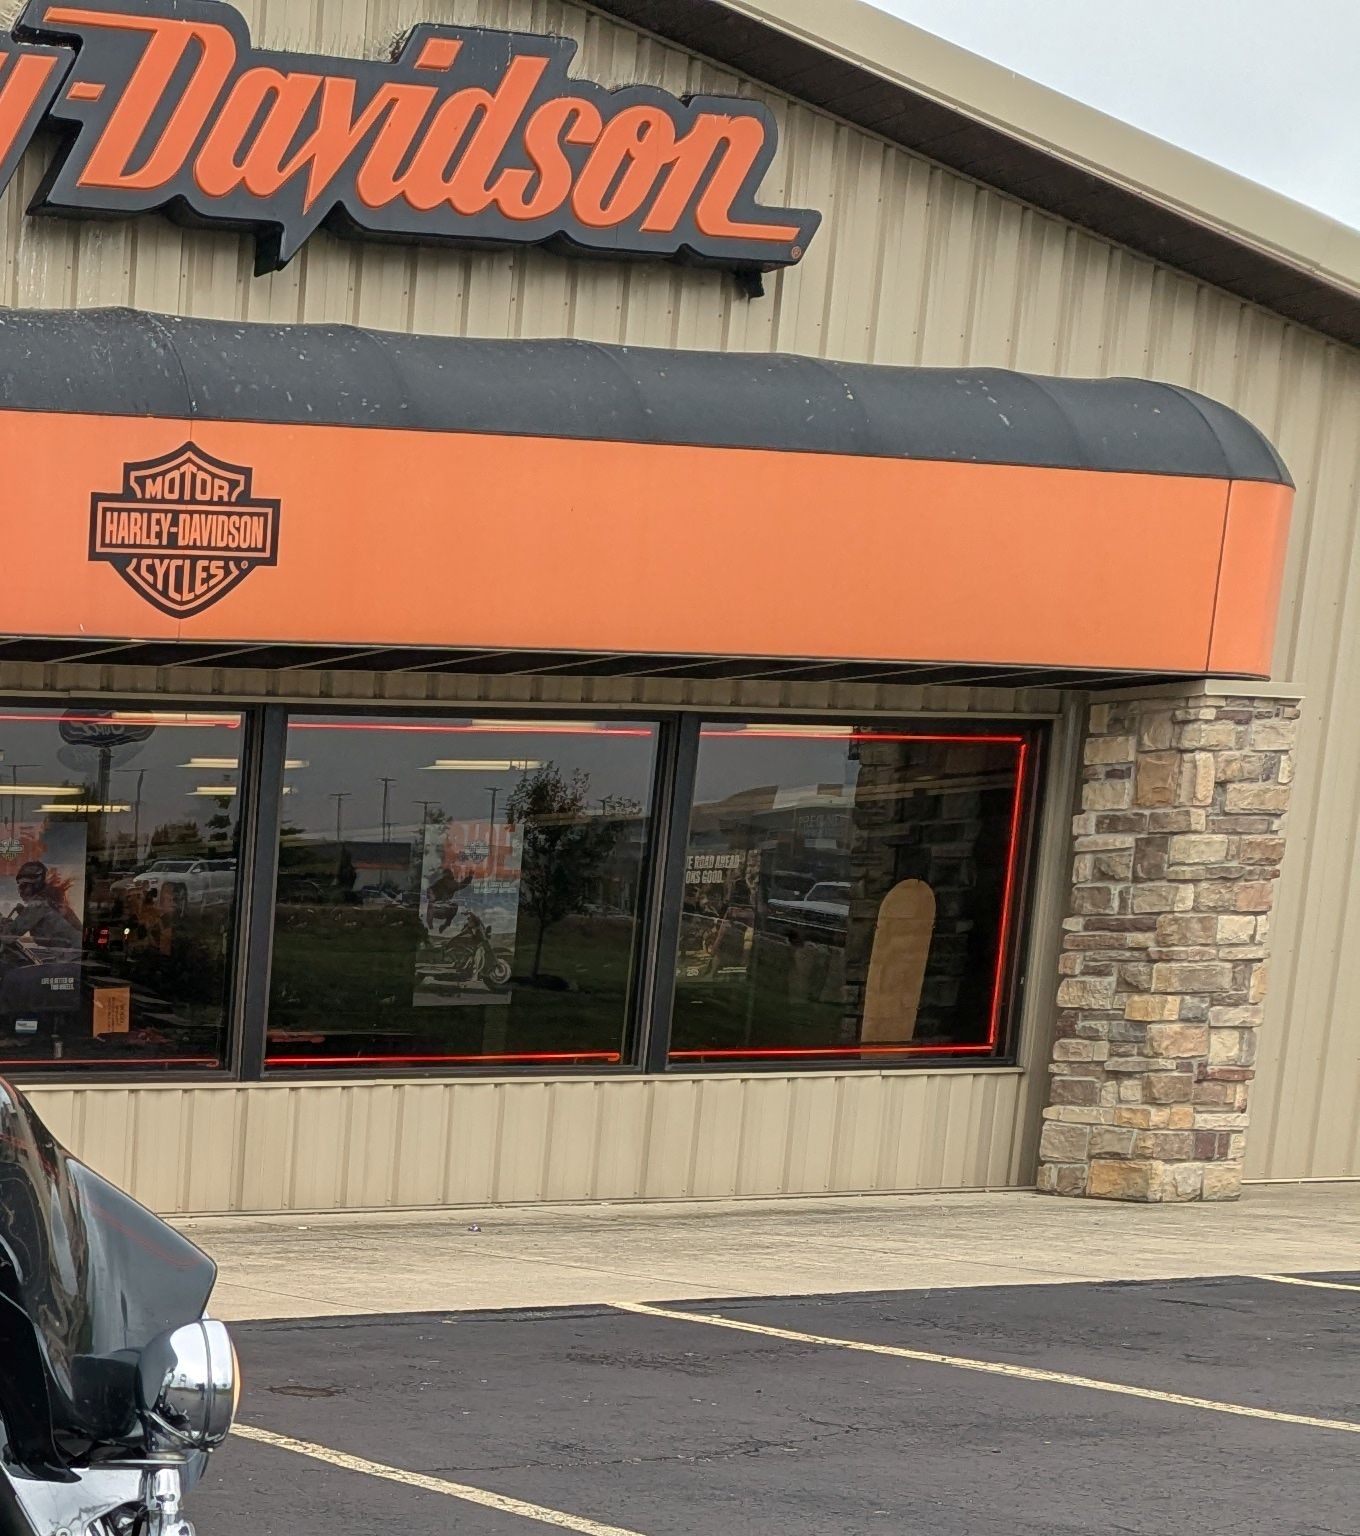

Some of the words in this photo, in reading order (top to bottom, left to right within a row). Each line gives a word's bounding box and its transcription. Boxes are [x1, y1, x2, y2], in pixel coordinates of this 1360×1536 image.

[144, 462, 231, 502] MOTOR
[104, 511, 265, 549] HARLEY-DAVIDSON
[139, 558, 225, 602] CYCLES
